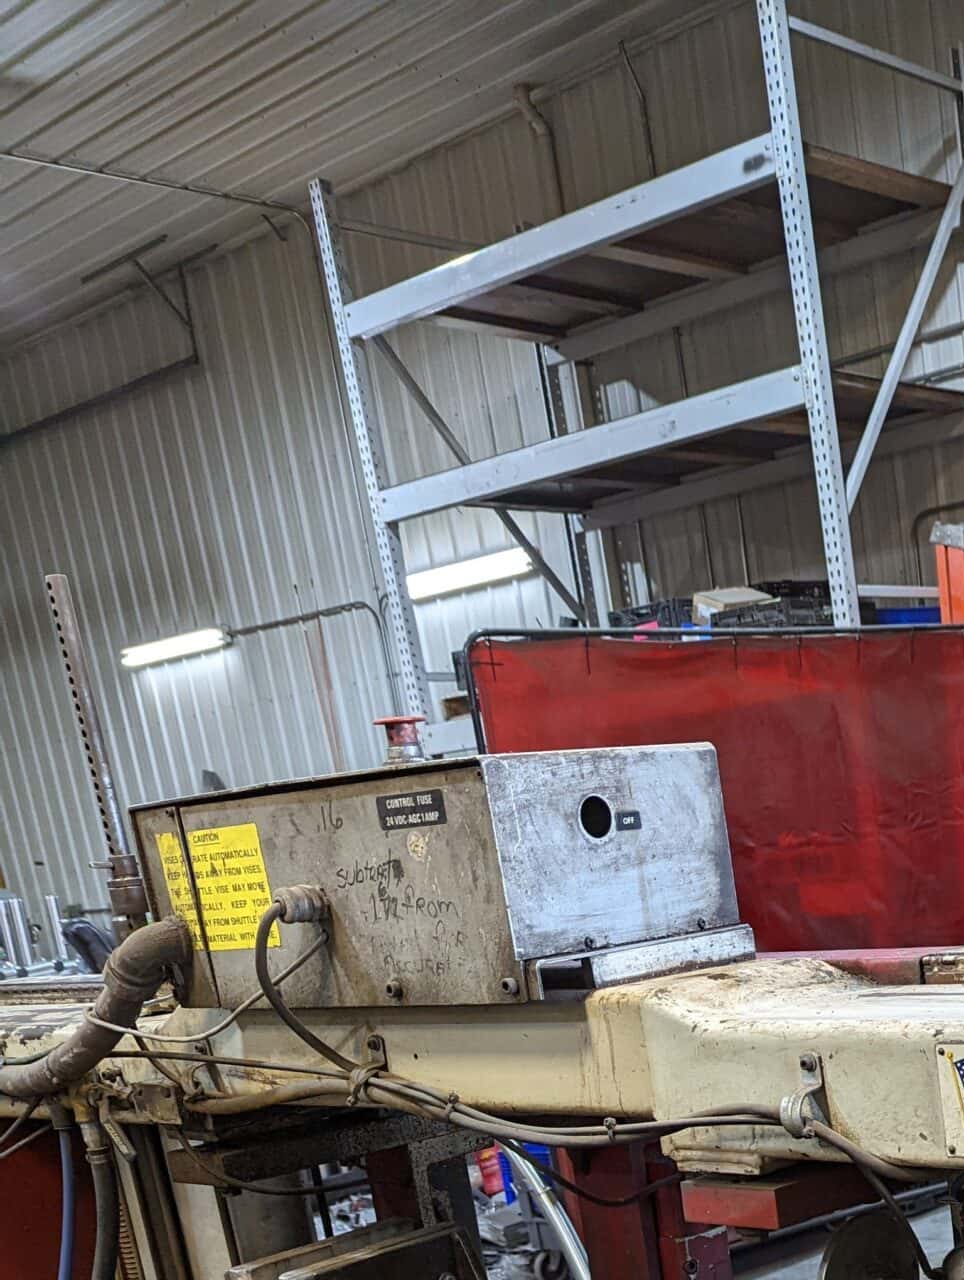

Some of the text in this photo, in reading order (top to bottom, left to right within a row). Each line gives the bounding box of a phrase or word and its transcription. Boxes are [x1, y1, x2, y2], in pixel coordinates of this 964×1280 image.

[386, 794, 432, 809] CONTROL FUSE
[425, 811, 439, 822] AMP
[193, 833, 219, 844] CAUTION
[209, 848, 258, 860] AUTOMATICALLY
[223, 867, 242, 876] FROM
[215, 885, 229, 893] VISE
[232, 883, 245, 892] MAY
[247, 881, 266, 891] MOVE
[231, 900, 247, 908] KEEP
[252, 898, 270, 907] YOUR
[213, 918, 230, 926] FROM
[231, 915, 258, 925] SHUTTLE
[207, 933, 237, 942] MATERIAL
